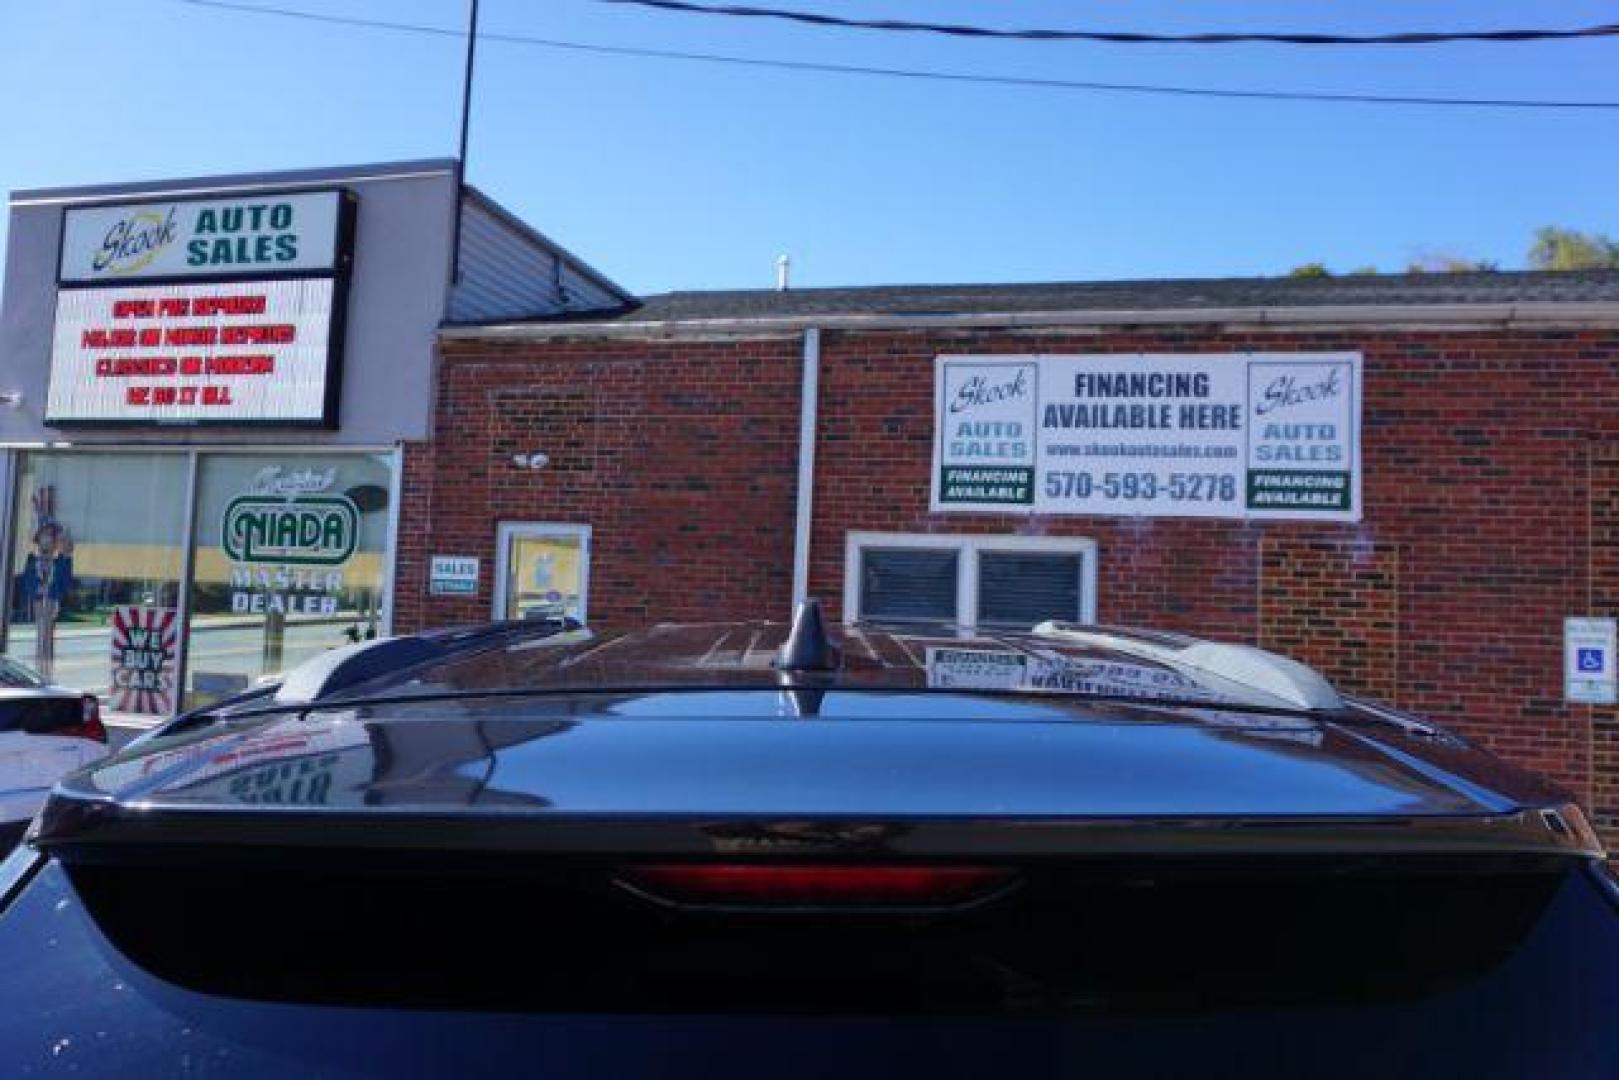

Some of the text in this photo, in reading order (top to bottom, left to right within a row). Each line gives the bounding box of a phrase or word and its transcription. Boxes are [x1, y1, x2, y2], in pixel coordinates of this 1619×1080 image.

[194, 203, 292, 233] AUTO
[94, 206, 177, 271] Skook
[187, 234, 297, 266] SALES
[950, 369, 1026, 412] Skook
[1074, 372, 1210, 398] FINANCING
[1255, 369, 1338, 415] Skook
[1043, 404, 1242, 430] AVAILABLE HERE
[958, 422, 1023, 437] AUTO
[1264, 424, 1337, 440] AUTO
[950, 442, 1027, 457] SALES
[1255, 445, 1342, 461] SALES
[948, 469, 1028, 483] FINANCING
[1045, 472, 1236, 501] 570-593-5278
[1254, 475, 1344, 488] FINANCING
[947, 485, 1026, 499] AVAILABLE
[1254, 491, 1342, 506] AVAILABLE
[234, 513, 343, 548] NIADA
[231, 566, 342, 588] MASTER
[232, 591, 337, 614] DEALER
[124, 649, 162, 669] BUY
